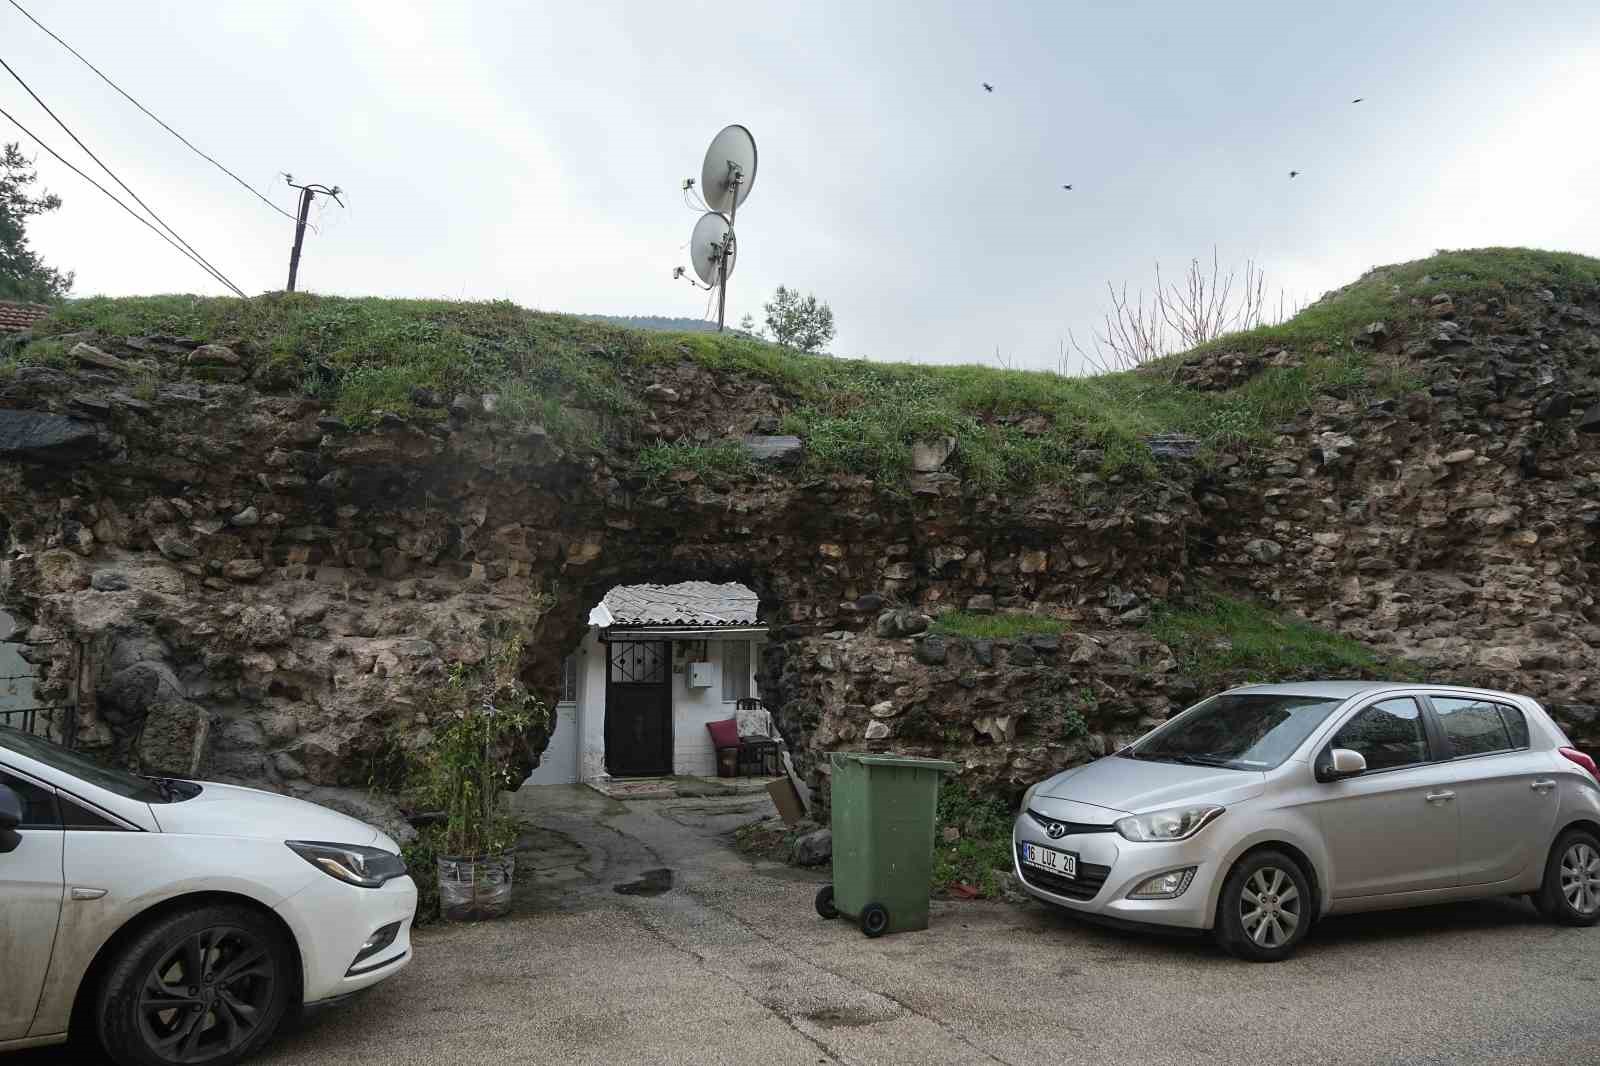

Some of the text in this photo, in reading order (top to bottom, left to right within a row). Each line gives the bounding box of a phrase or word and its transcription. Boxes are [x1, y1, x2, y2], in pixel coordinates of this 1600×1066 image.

[1028, 845, 1035, 861] 16
[1042, 848, 1056, 867] LUZ
[1063, 855, 1074, 873] 20
